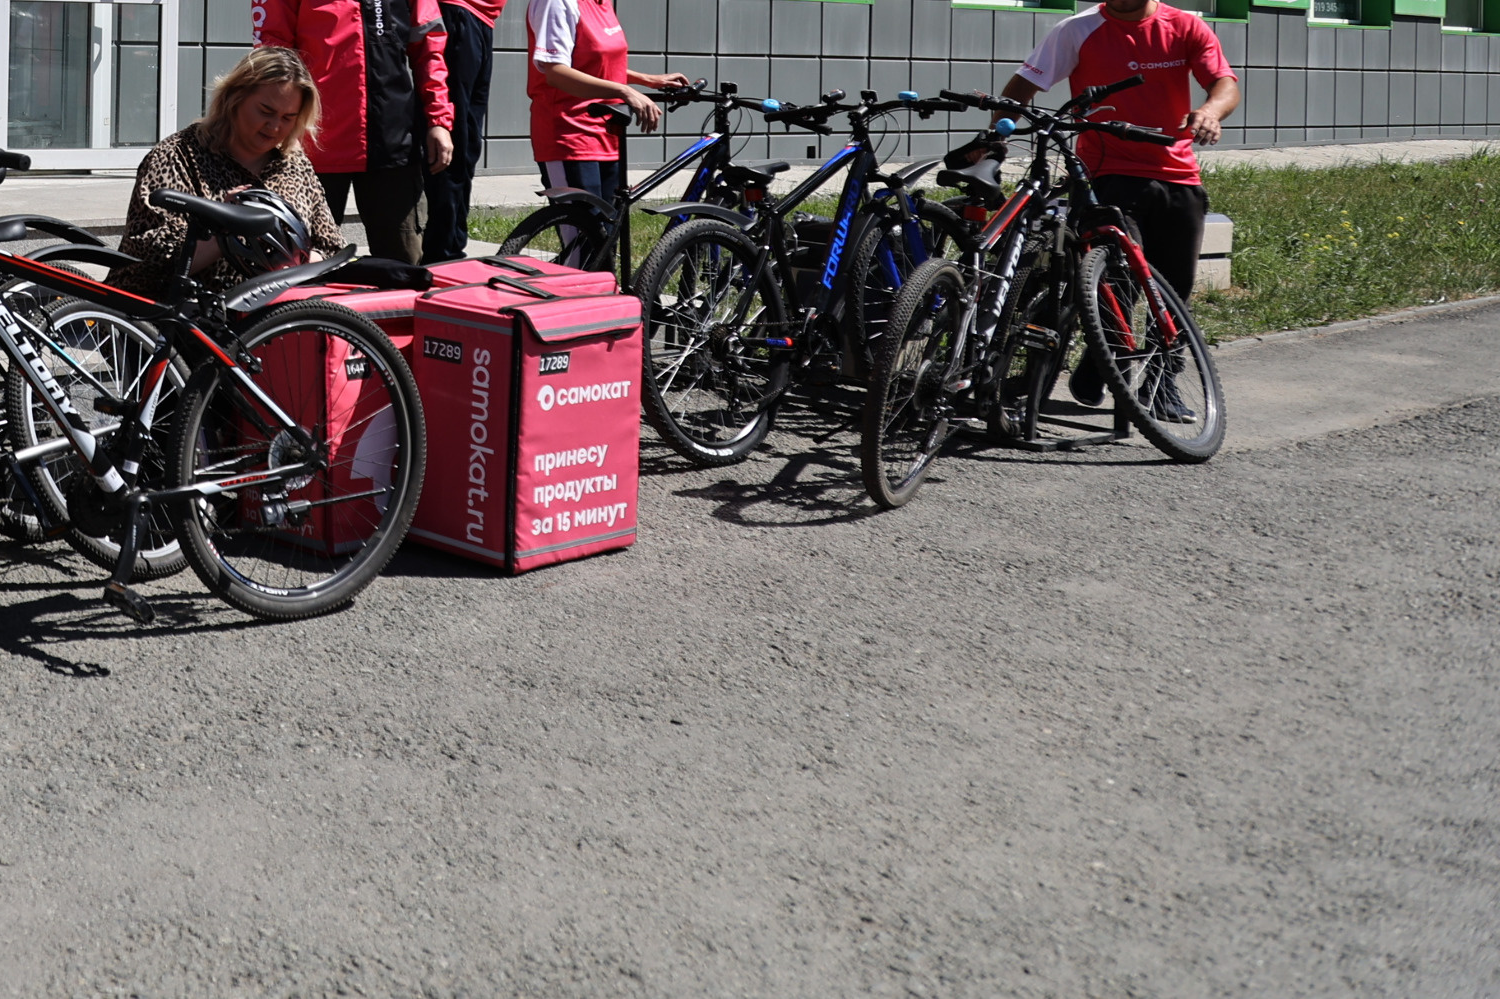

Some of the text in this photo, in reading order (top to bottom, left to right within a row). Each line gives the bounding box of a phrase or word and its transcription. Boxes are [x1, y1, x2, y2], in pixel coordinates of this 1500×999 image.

[1140, 59, 1186, 70] самокат
[424, 340, 462, 360] 17289
[538, 355, 570, 372] 17289
[556, 380, 632, 406] самокат
[466, 348, 494, 544] samokat.ru
[534, 443, 609, 476] принесу
[533, 473, 618, 508] продукты
[530, 502, 628, 536] за 15 минут
